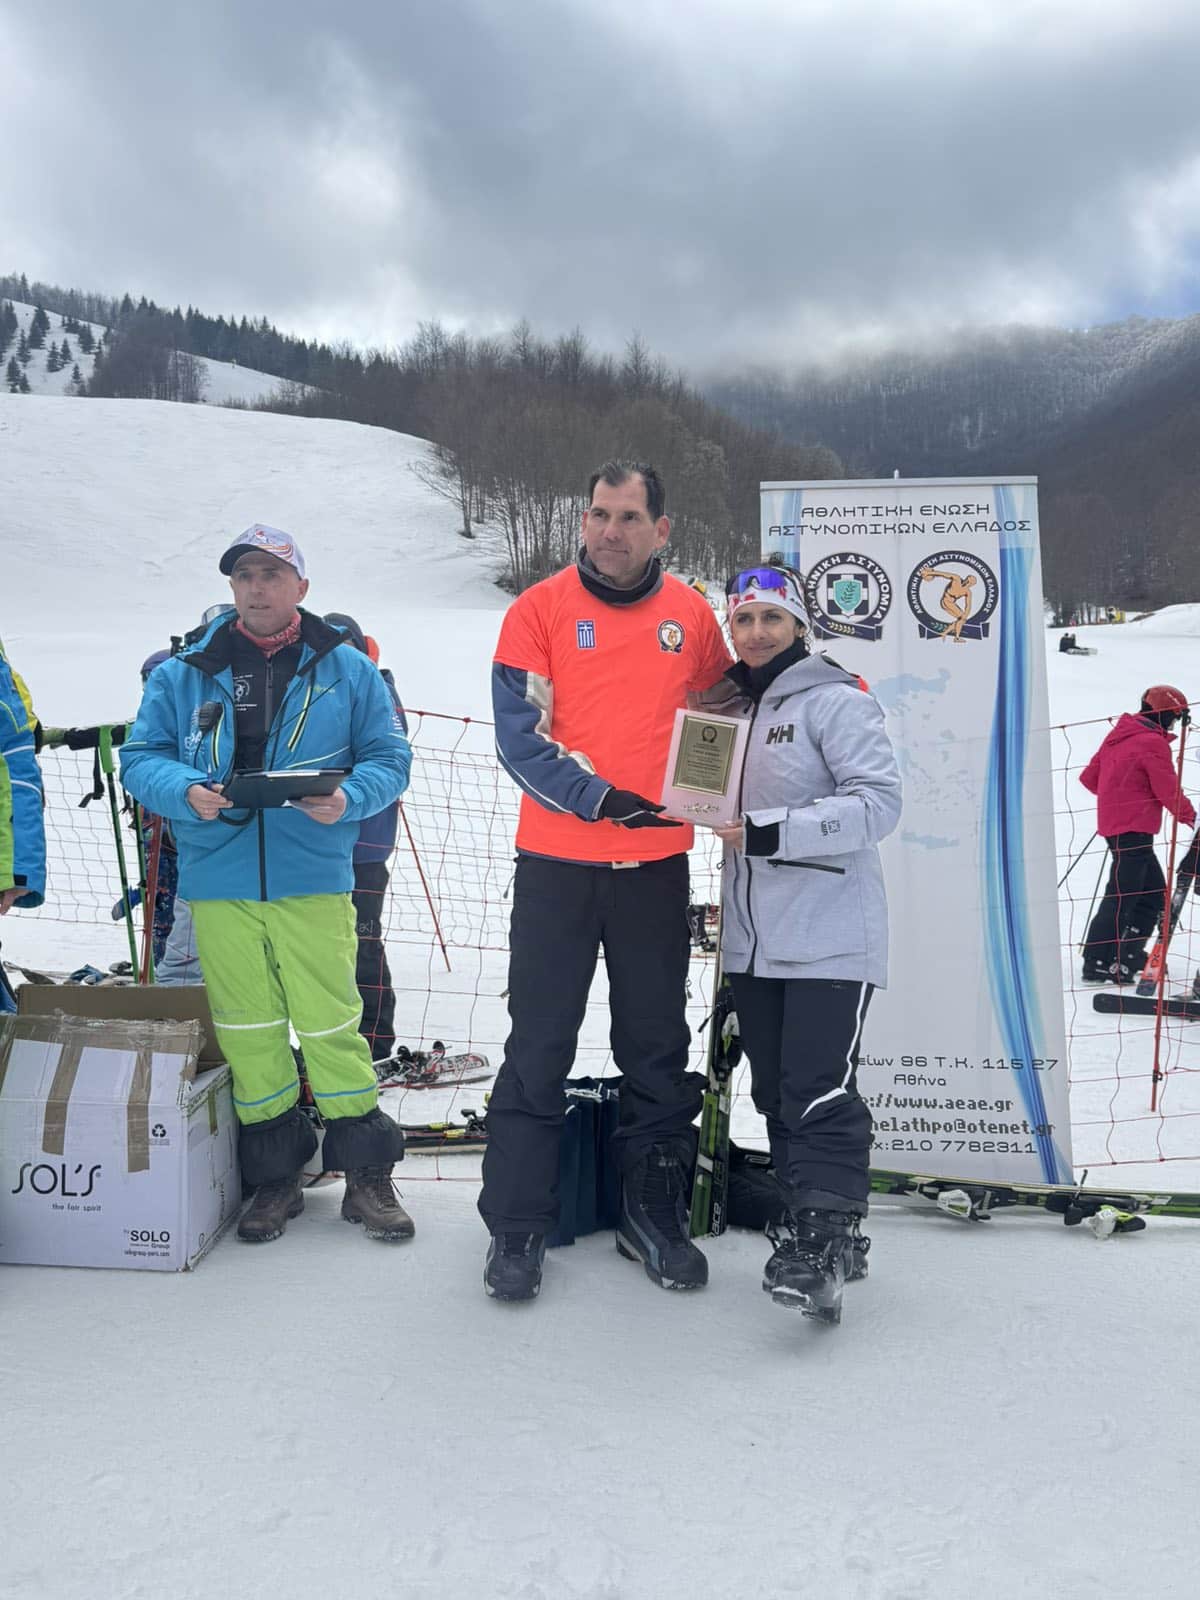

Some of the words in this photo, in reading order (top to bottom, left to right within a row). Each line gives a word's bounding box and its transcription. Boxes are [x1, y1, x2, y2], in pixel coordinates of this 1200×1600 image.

[801, 505, 912, 518] ΑΘΛΗΤΙΚΗ
[920, 503, 990, 516] ΕΝΩΣΗ
[768, 522, 925, 537] ΑΣΤΥΝΟΜΙΚΩΝ
[933, 520, 1032, 534] ΕΛΛΑΔΟΣ
[846, 554, 890, 619] ΑΣΤΥΝΟΜΙΑ
[857, 1054, 894, 1067] είων
[900, 1055, 928, 1068] 96
[982, 1057, 1025, 1071] 115
[1031, 1058, 1059, 1071] 27
[894, 1073, 947, 1087] Αθήνα
[861, 1093, 1015, 1113] ://www.aeae.gr
[872, 1117, 1056, 1137] elathpo@otenet.gr
[868, 1139, 932, 1152] x:210
[940, 1140, 1037, 1154] 7782311
[130, 1230, 170, 1242] SOLO
